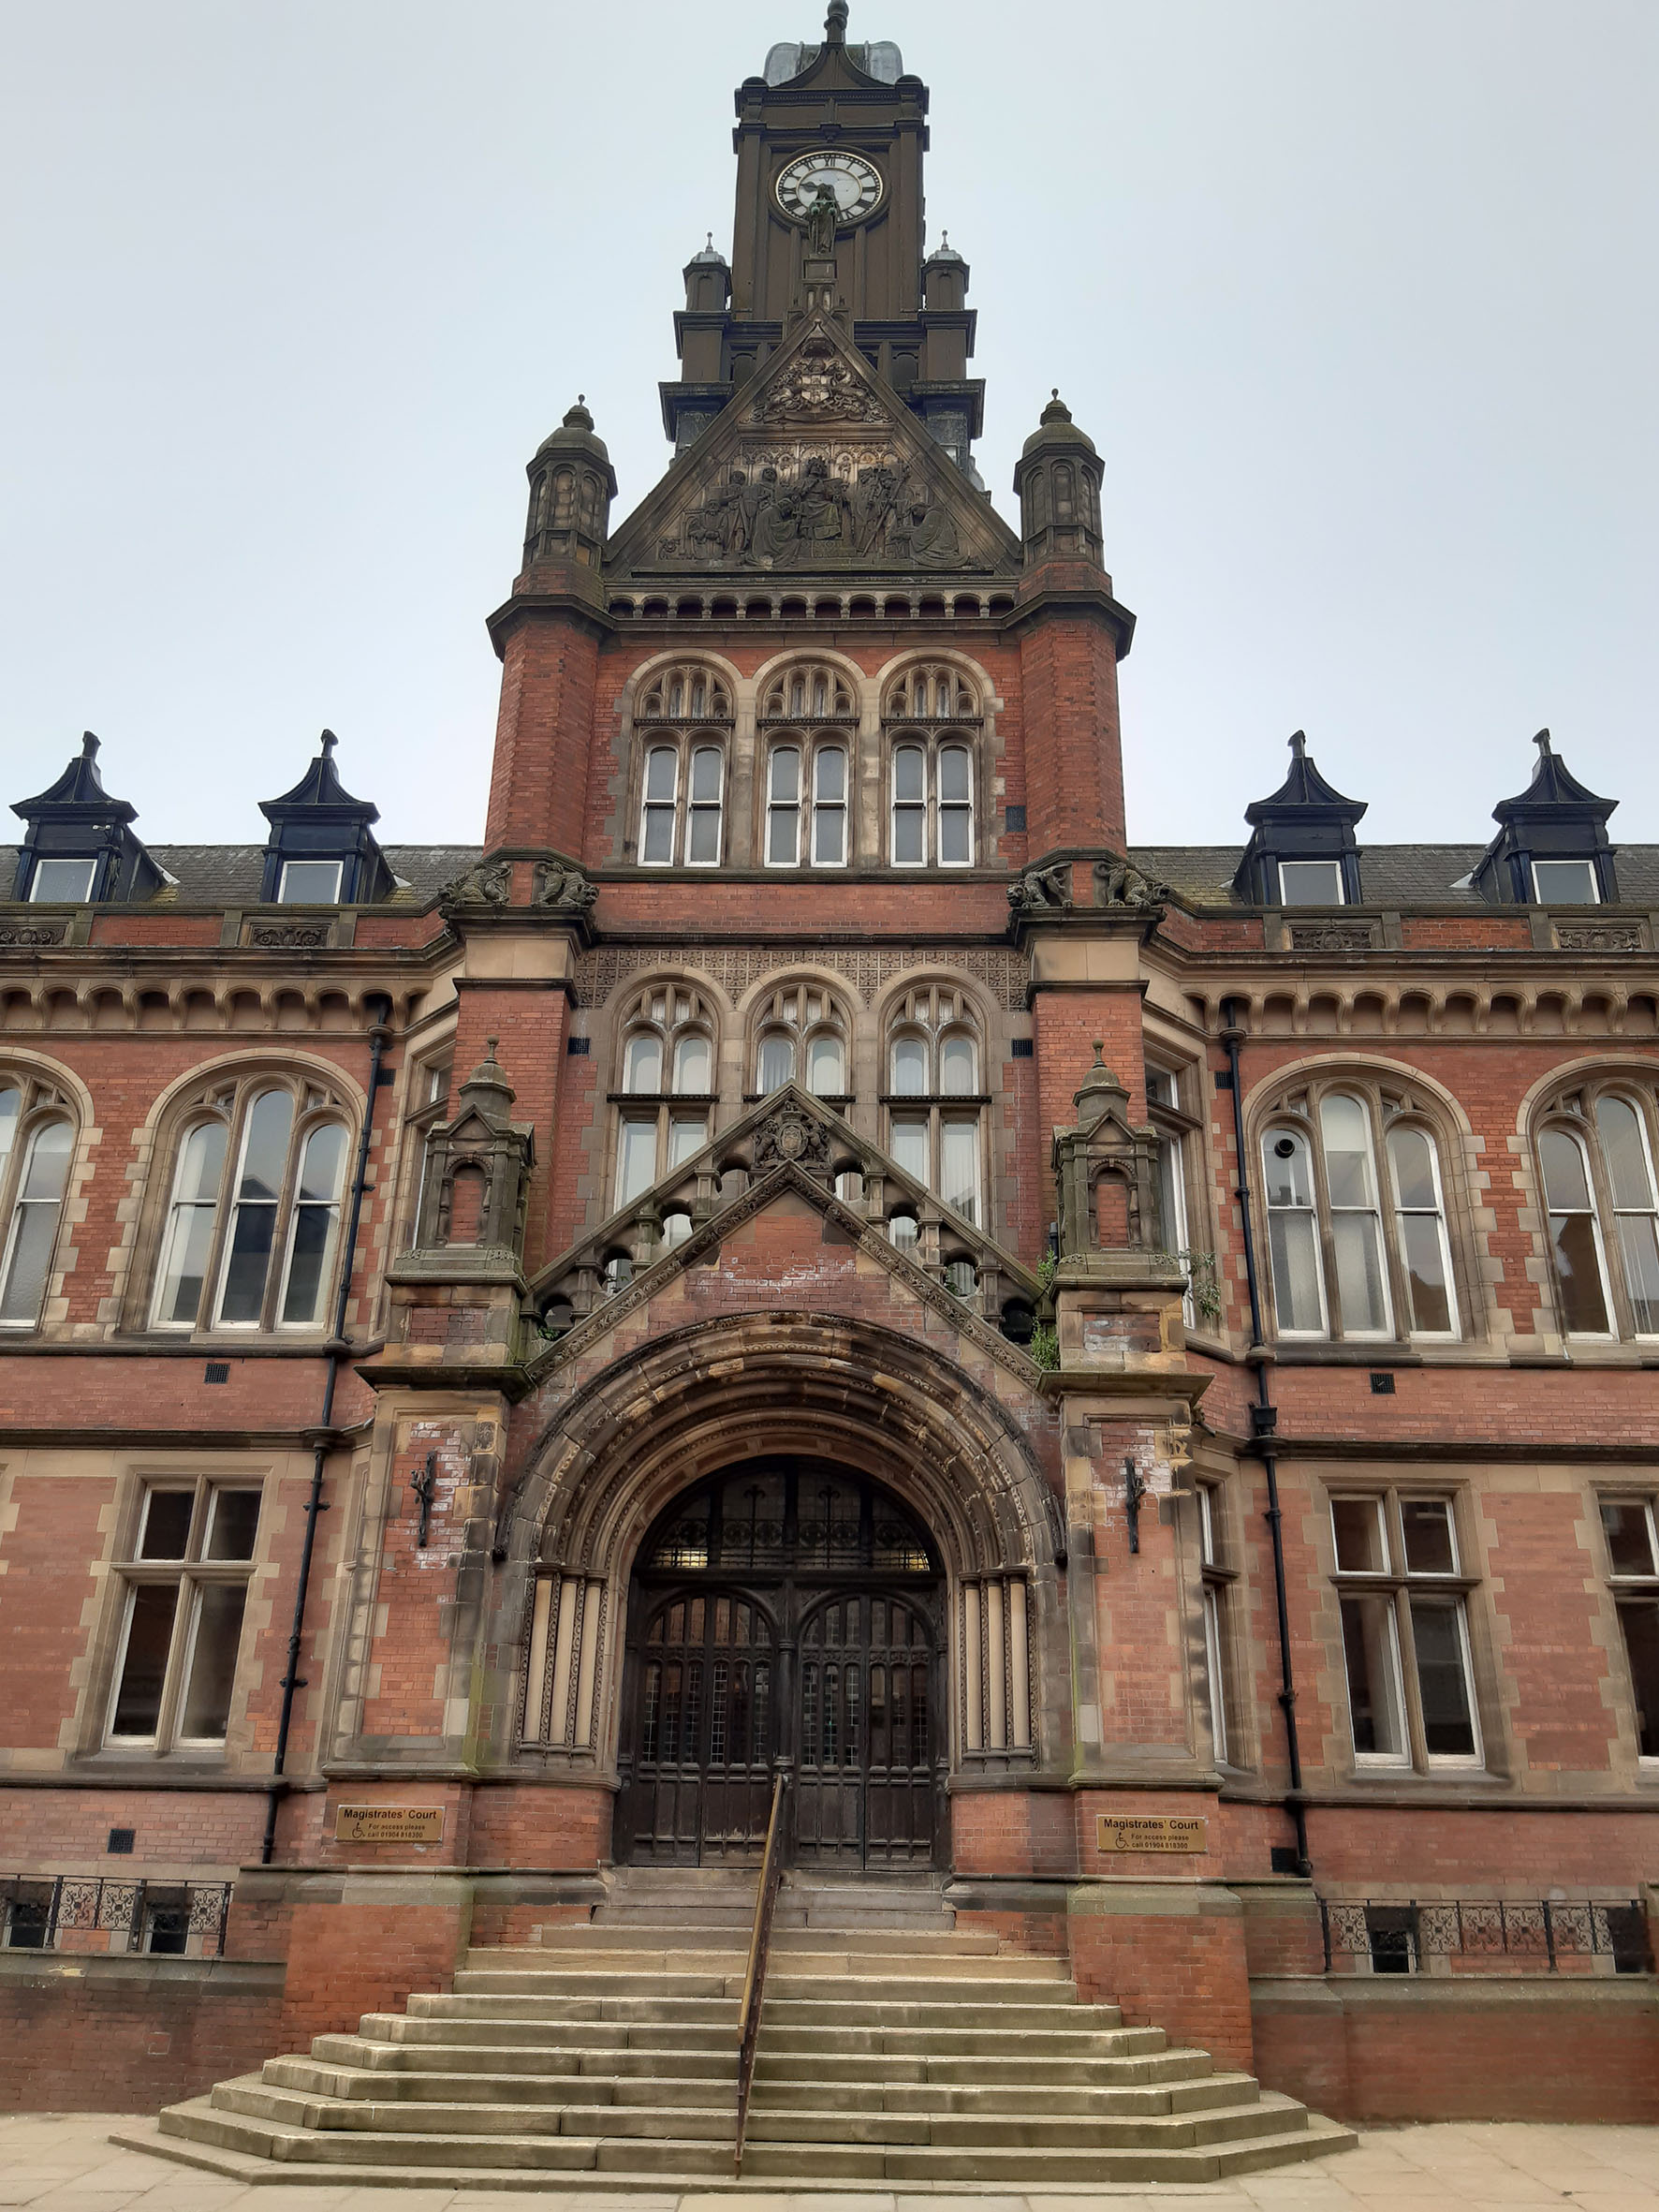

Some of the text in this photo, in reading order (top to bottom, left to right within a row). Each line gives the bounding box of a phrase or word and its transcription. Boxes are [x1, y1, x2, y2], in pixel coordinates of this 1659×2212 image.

[804, 161, 815, 170] XI
[825, 158, 835, 167] XII
[344, 1809, 436, 1820] Magistrates' Court
[1104, 1819, 1198, 1830] Magistrates' Court
